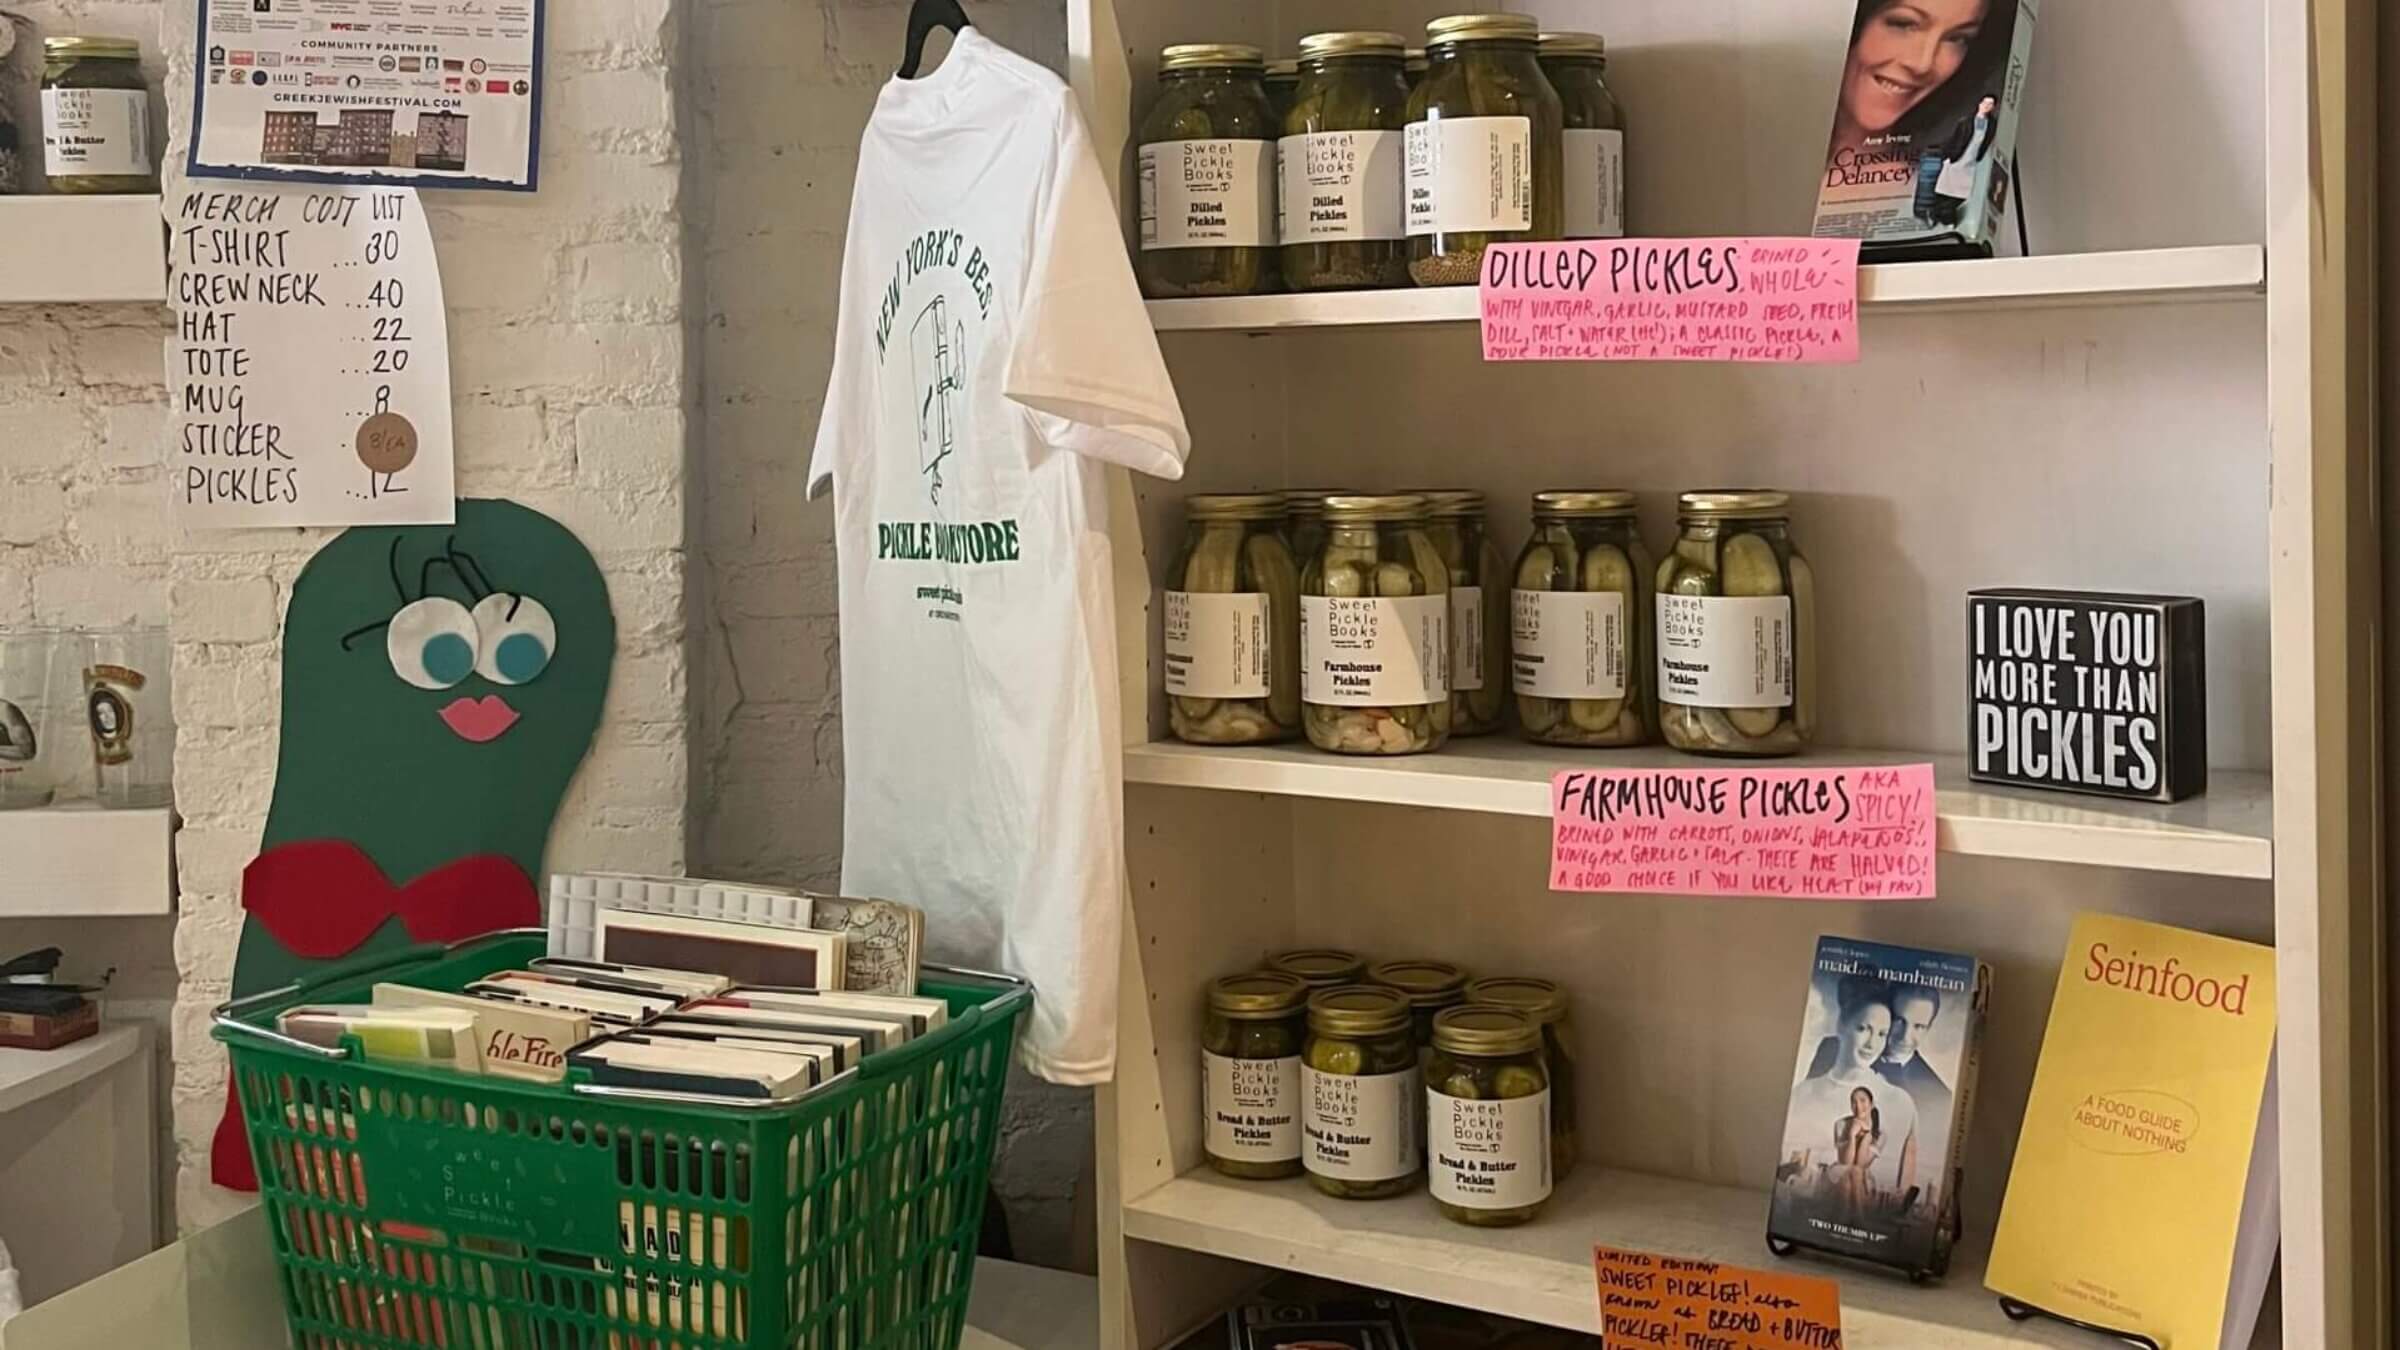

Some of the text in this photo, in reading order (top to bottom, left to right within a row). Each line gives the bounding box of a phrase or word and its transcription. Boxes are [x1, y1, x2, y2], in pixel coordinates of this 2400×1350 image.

[301, 40, 438, 53] COMMUNITY PARTNERS
[273, 92, 462, 108] GREEKJEWISHFESTIVAL.COM
[1184, 143, 1232, 155] Sweet
[1307, 149, 1355, 161] Pickle
[1834, 147, 1914, 167] Crossing
[1184, 157, 1233, 169] Pickle
[1307, 162, 1354, 175] Books
[1184, 169, 1233, 181] Books
[1827, 165, 1912, 188] Delancey
[181, 191, 405, 227] MERCH COST LIST
[1190, 202, 1223, 212] Dilled
[1312, 195, 1344, 207] Dilled
[1187, 215, 1227, 227] Pickles
[1310, 210, 1348, 221] Pickles
[182, 225, 289, 267] T-SHIRT
[1750, 267, 1828, 295] WHOLE
[876, 260, 901, 366] NEW
[905, 228, 964, 286] YORK'S
[1486, 299, 1523, 319] WITH
[1675, 301, 1748, 320] MUSTARD
[1810, 299, 1853, 321] FRESH
[183, 311, 236, 343] HAT
[1532, 323, 1566, 343] SALT
[1697, 324, 1757, 343] CLASSIC
[1831, 329, 1841, 343] A
[1539, 345, 1598, 358] PICKLE
[1650, 346, 1658, 357] A
[1673, 344, 1717, 358] SWEET
[183, 348, 250, 377] TOTE
[185, 384, 243, 424] MUG
[183, 423, 294, 461] STICKER
[187, 466, 297, 504] PICKLES
[878, 521, 933, 560] PICKLE
[1329, 598, 1377, 611] Sweet
[1665, 596, 1704, 610] Sweet
[1329, 612, 1378, 625] Pickle
[1664, 609, 1704, 625] Pickle
[1330, 624, 1377, 637] Books
[1665, 621, 1704, 636] Books
[1975, 604, 2155, 667] I LOVE YOU
[1324, 660, 1382, 672] Farmhouse
[1662, 657, 1710, 673] Farmhouse
[1333, 675, 1371, 686] Pickles
[1668, 673, 1699, 685] Pickles
[1975, 658, 2157, 714] MORE THAN
[1977, 703, 2157, 790] PICKLES
[1858, 770, 1900, 790] AKA
[1560, 773, 1729, 823] FARMHOUSE
[1855, 787, 1921, 826] SPICY!
[1557, 825, 1614, 844] BRINED
[1622, 825, 1658, 842] WITH
[1630, 845, 1689, 864] GARLIC
[1705, 848, 1744, 866] SALT
[1757, 849, 1801, 869] THESE
[1809, 853, 1839, 872] ARE
[1850, 852, 1929, 878] HALVED!
[1558, 870, 1567, 885] A
[1575, 871, 1612, 889] GOOD
[1627, 870, 1677, 887] CHOICE
[1689, 870, 1700, 888] IF
[1712, 872, 1739, 889] YOU
[1751, 874, 1793, 894] LIKE
[1802, 876, 1855, 894] HEAT
[1819, 957, 1965, 993] maid manhattan
[2084, 941, 2249, 1016] Seinfood
[521, 1034, 564, 1069] Fire
[1232, 1057, 1279, 1072] Sweet
[1232, 1071, 1280, 1085] Pickle
[1315, 1073, 1358, 1089] Sweet
[1233, 1084, 1280, 1096] Books
[1315, 1085, 1358, 1104] Pickle
[1315, 1097, 1358, 1115] Books
[1453, 1100, 1503, 1115] Sweet
[2083, 1093, 2183, 1134] A FOOD GUIDE
[1217, 1111, 1292, 1126] Bread & Butter
[1453, 1113, 1504, 1130] Pickle
[1234, 1128, 1272, 1139] Pickles
[1325, 1130, 1334, 1142] &
[1336, 1133, 1372, 1145] Butter
[1454, 1126, 1503, 1141] Books
[2074, 1109, 2188, 1154] ABOUT NOTHING
[1316, 1142, 1350, 1157] Pickles
[1439, 1152, 1518, 1172] Bread & Butter
[1456, 1172, 1495, 1186] Pickles
[444, 1186, 516, 1212] Pickle
[1600, 1267, 1657, 1291] SWEET
[1708, 1308, 1761, 1333] BREAD
